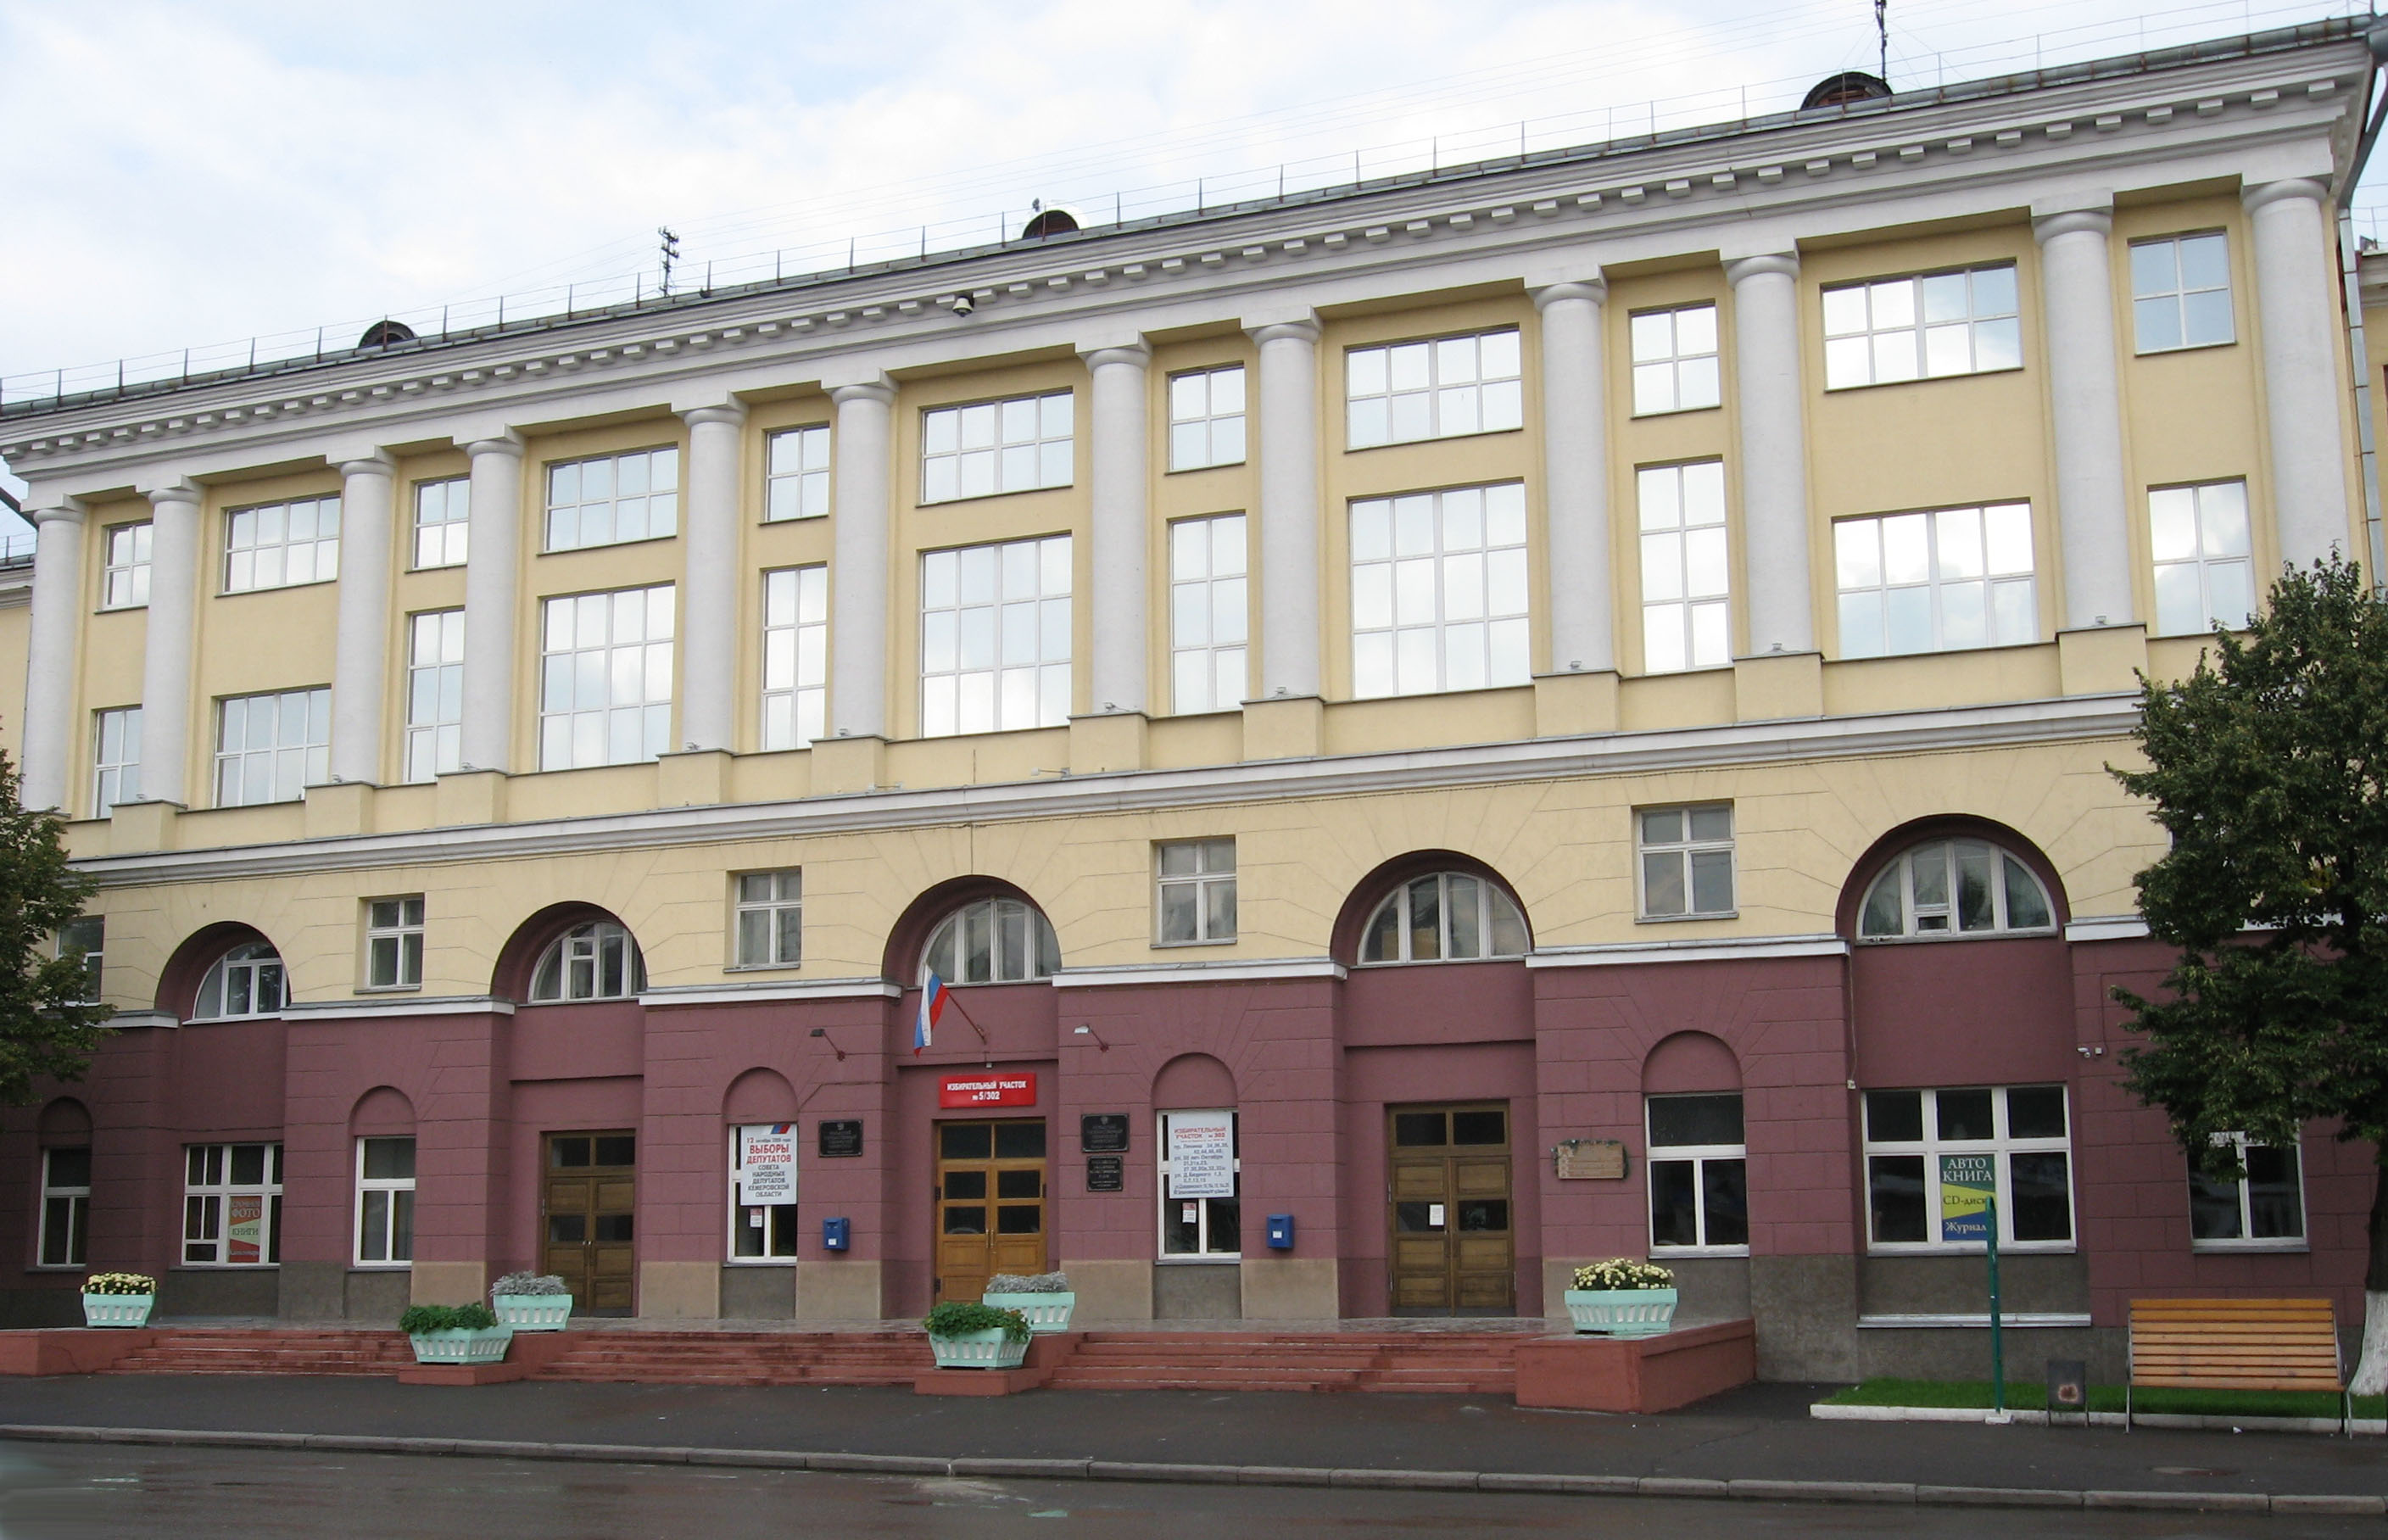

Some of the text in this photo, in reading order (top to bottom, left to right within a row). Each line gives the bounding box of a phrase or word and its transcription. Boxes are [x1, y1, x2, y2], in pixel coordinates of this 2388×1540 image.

[946, 1080, 1027, 1091] ИЗБИРАТЕЛЬНЫЙ УЧАСТОК
[979, 1091, 1001, 1101] 5/302
[750, 1143, 789, 1154] ВЫБОРЫ
[746, 1154, 792, 1164] ДЕПУТАТОВ
[1947, 1158, 1987, 1169] АВТО
[1943, 1170, 1993, 1181] КНИГА
[231, 1208, 260, 1218] ФОТО
